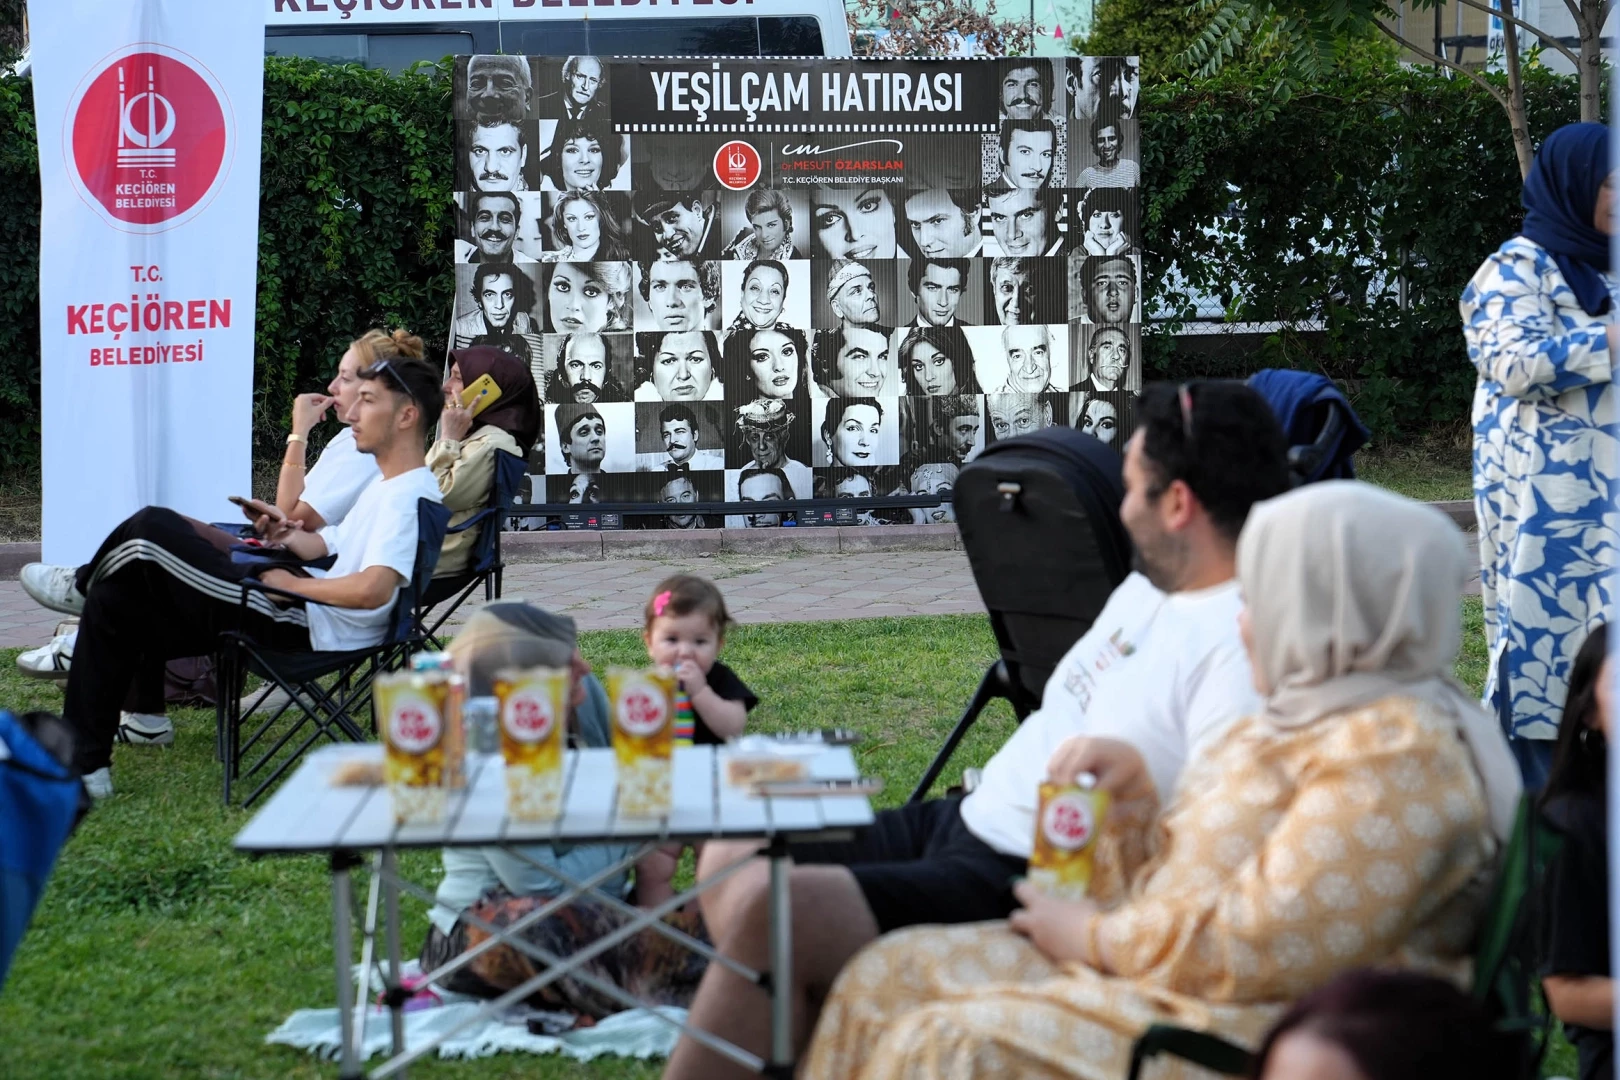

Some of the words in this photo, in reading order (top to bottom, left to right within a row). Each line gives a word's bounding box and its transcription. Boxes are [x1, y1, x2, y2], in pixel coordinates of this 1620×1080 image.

[650, 62, 810, 122] YEŞİLÇAM
[823, 72, 962, 112] HATIRASI
[835, 159, 904, 170] ÖZARSLAN
[139, 169, 157, 178] T.C.
[782, 176, 796, 184] T.C.
[797, 175, 833, 185] KEÇİÖREN
[835, 175, 870, 184] BELEDİYE
[871, 176, 904, 184] BAŞKANI
[115, 181, 176, 197] KEÇİÖREN
[115, 195, 176, 209] BELEDİYESİ
[130, 265, 163, 282] T.C.
[67, 294, 231, 340] KEÇİÖREN
[90, 340, 203, 366] BELEDİYESİ
